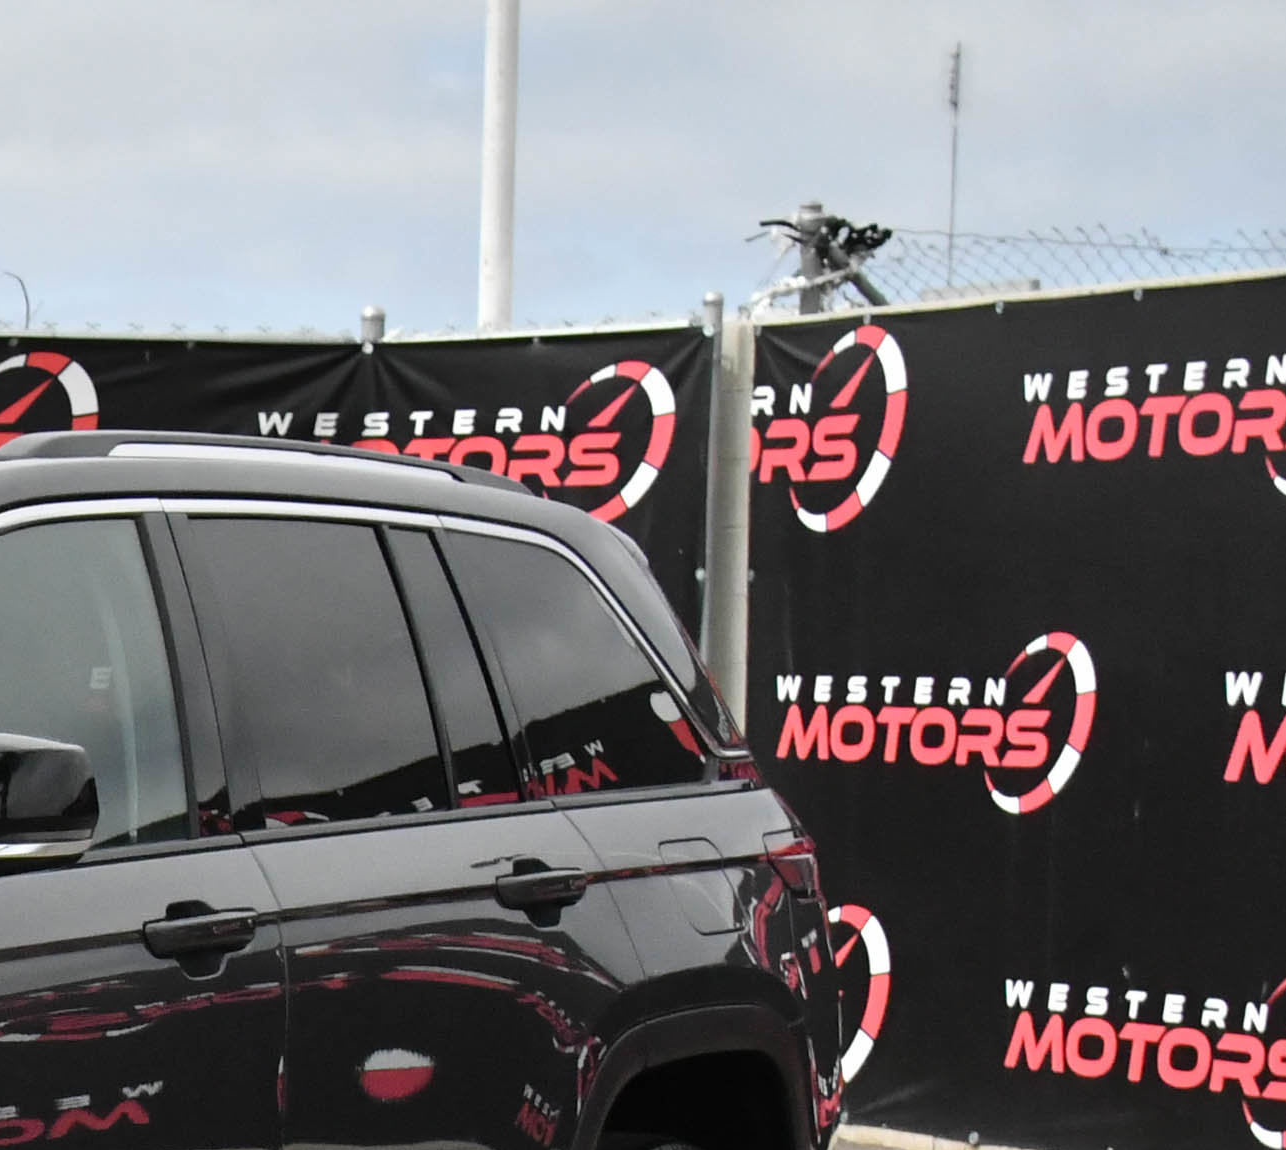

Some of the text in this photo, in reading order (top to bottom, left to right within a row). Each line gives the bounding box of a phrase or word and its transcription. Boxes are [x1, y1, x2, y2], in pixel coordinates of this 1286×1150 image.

[258, 405, 566, 436] WESTERN
[776, 675, 1006, 706] WESTERN
[776, 704, 1051, 768] MOTORS
[1005, 979, 1269, 1033] WESTERN
